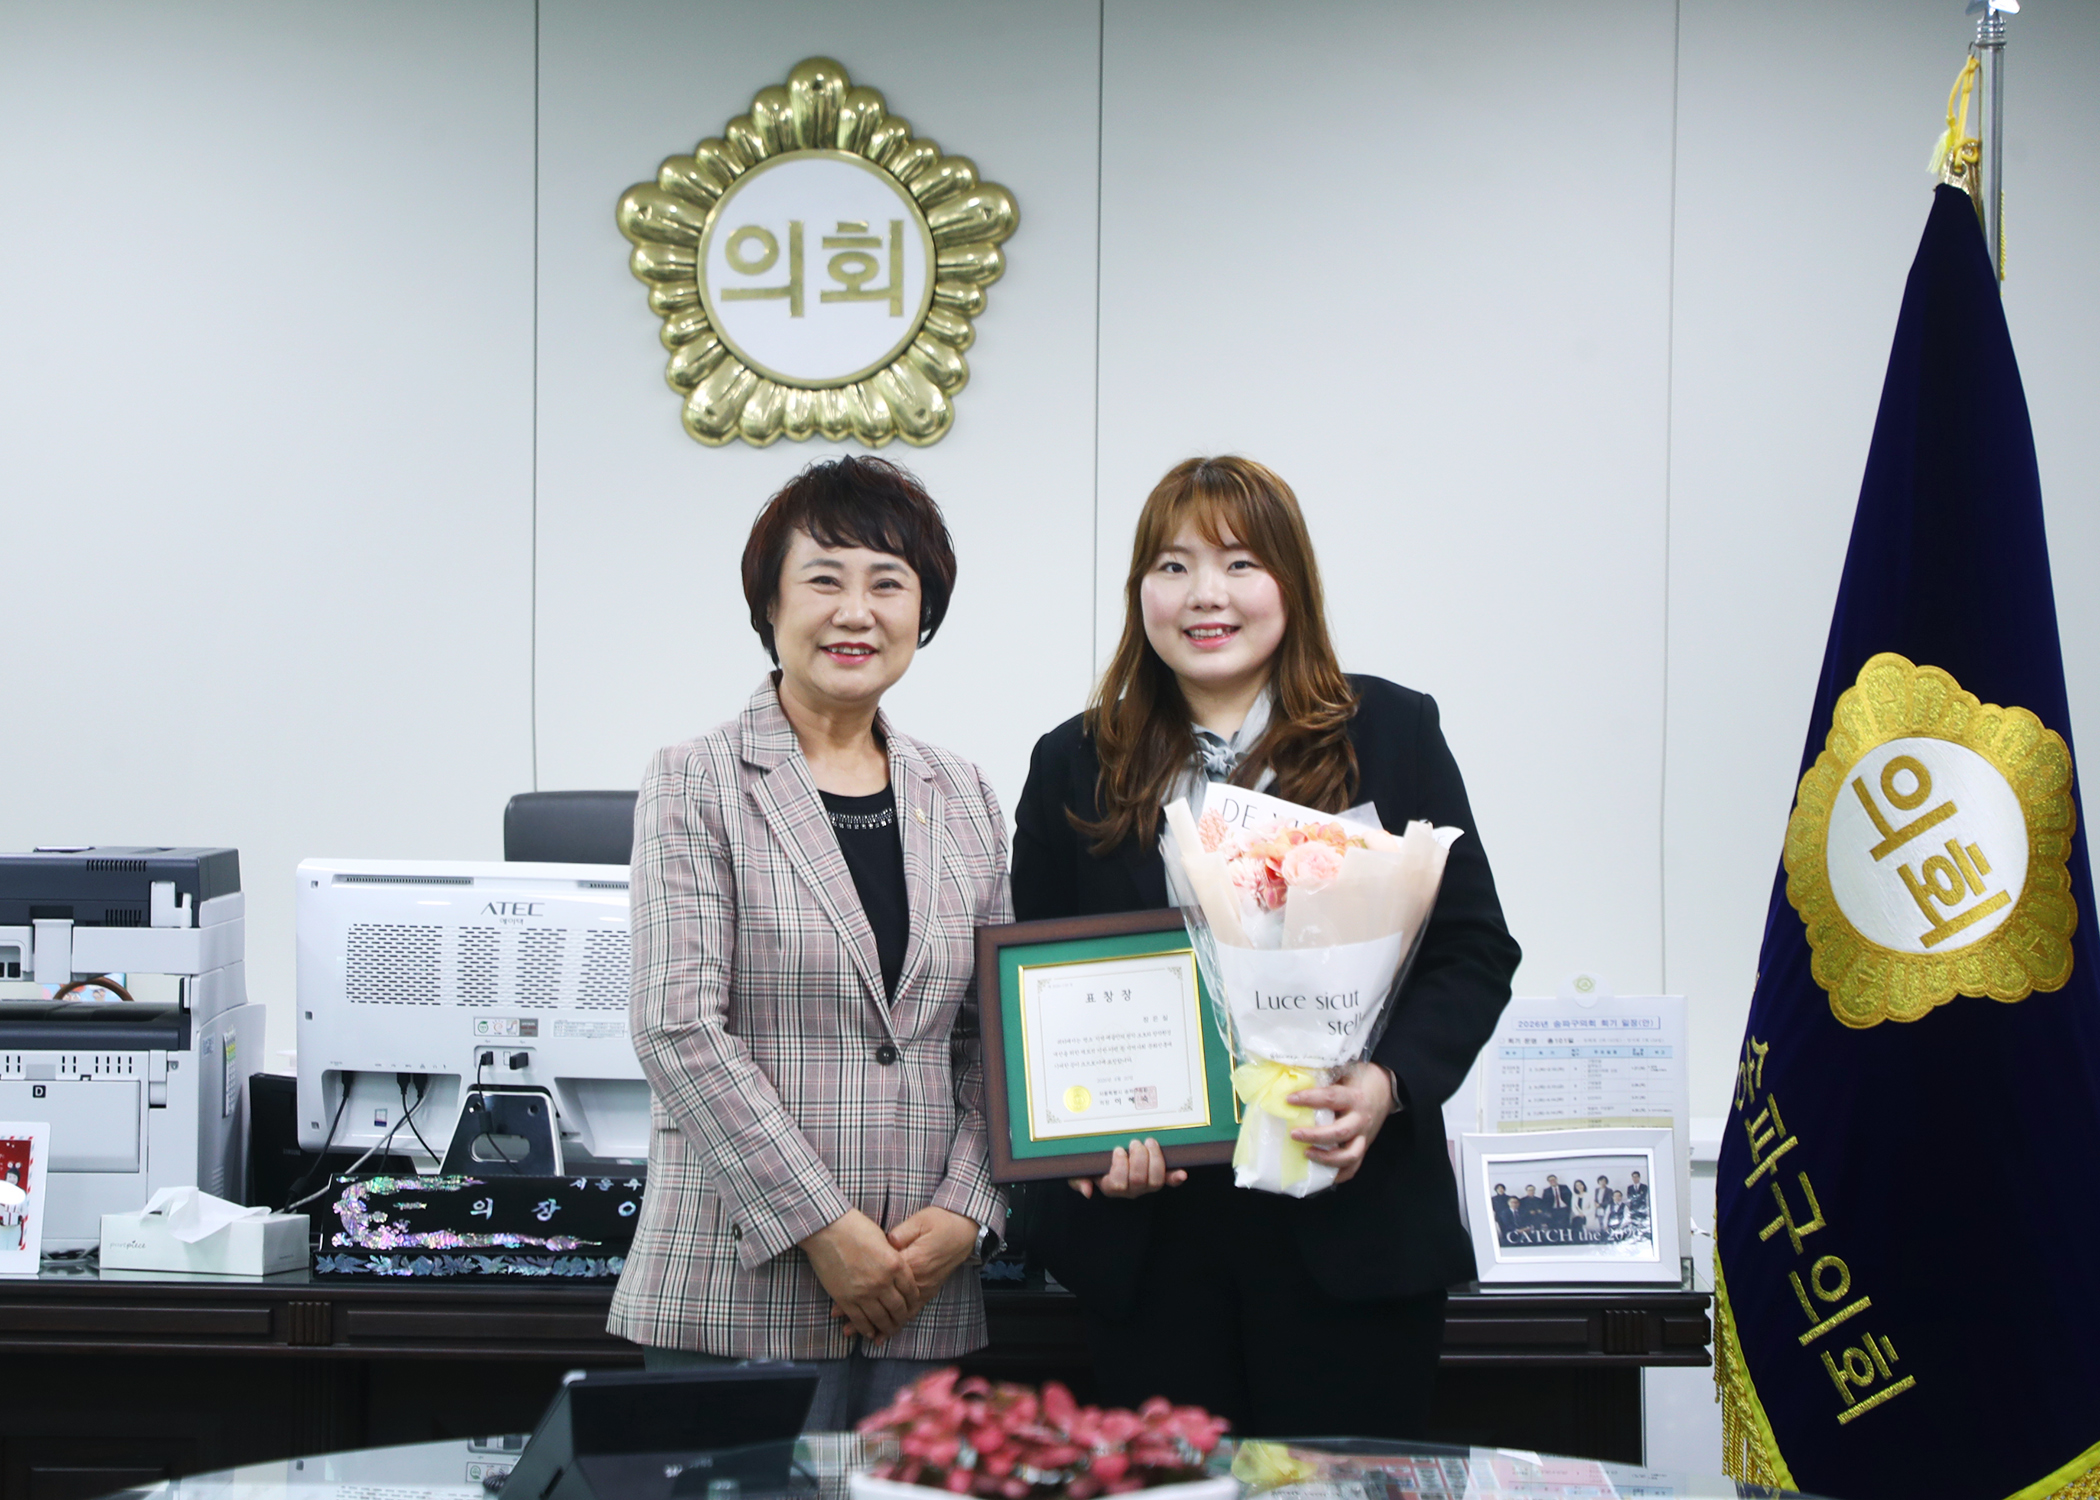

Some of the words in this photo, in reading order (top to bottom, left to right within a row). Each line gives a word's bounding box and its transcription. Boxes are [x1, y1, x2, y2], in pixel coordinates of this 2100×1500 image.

[721, 219, 904, 318] 의회
[1852, 753, 2012, 949] 의회
[480, 901, 545, 917] ATEC
[1085, 989, 1132, 1004] 표창장
[1255, 990, 1306, 1010] Luce
[1316, 990, 1359, 1010] sicut
[1518, 1020, 1549, 1029] 2026년
[1553, 1019, 1596, 1028] 송파구의회
[1601, 1019, 1618, 1028] 회기
[1622, 1019, 1655, 1028] 일정(안)
[34, 1086, 45, 1097] D
[1506, 1228, 1573, 1244] CATCH
[1578, 1227, 1601, 1241] the
[1735, 1035, 1916, 1425] 송파구의회
